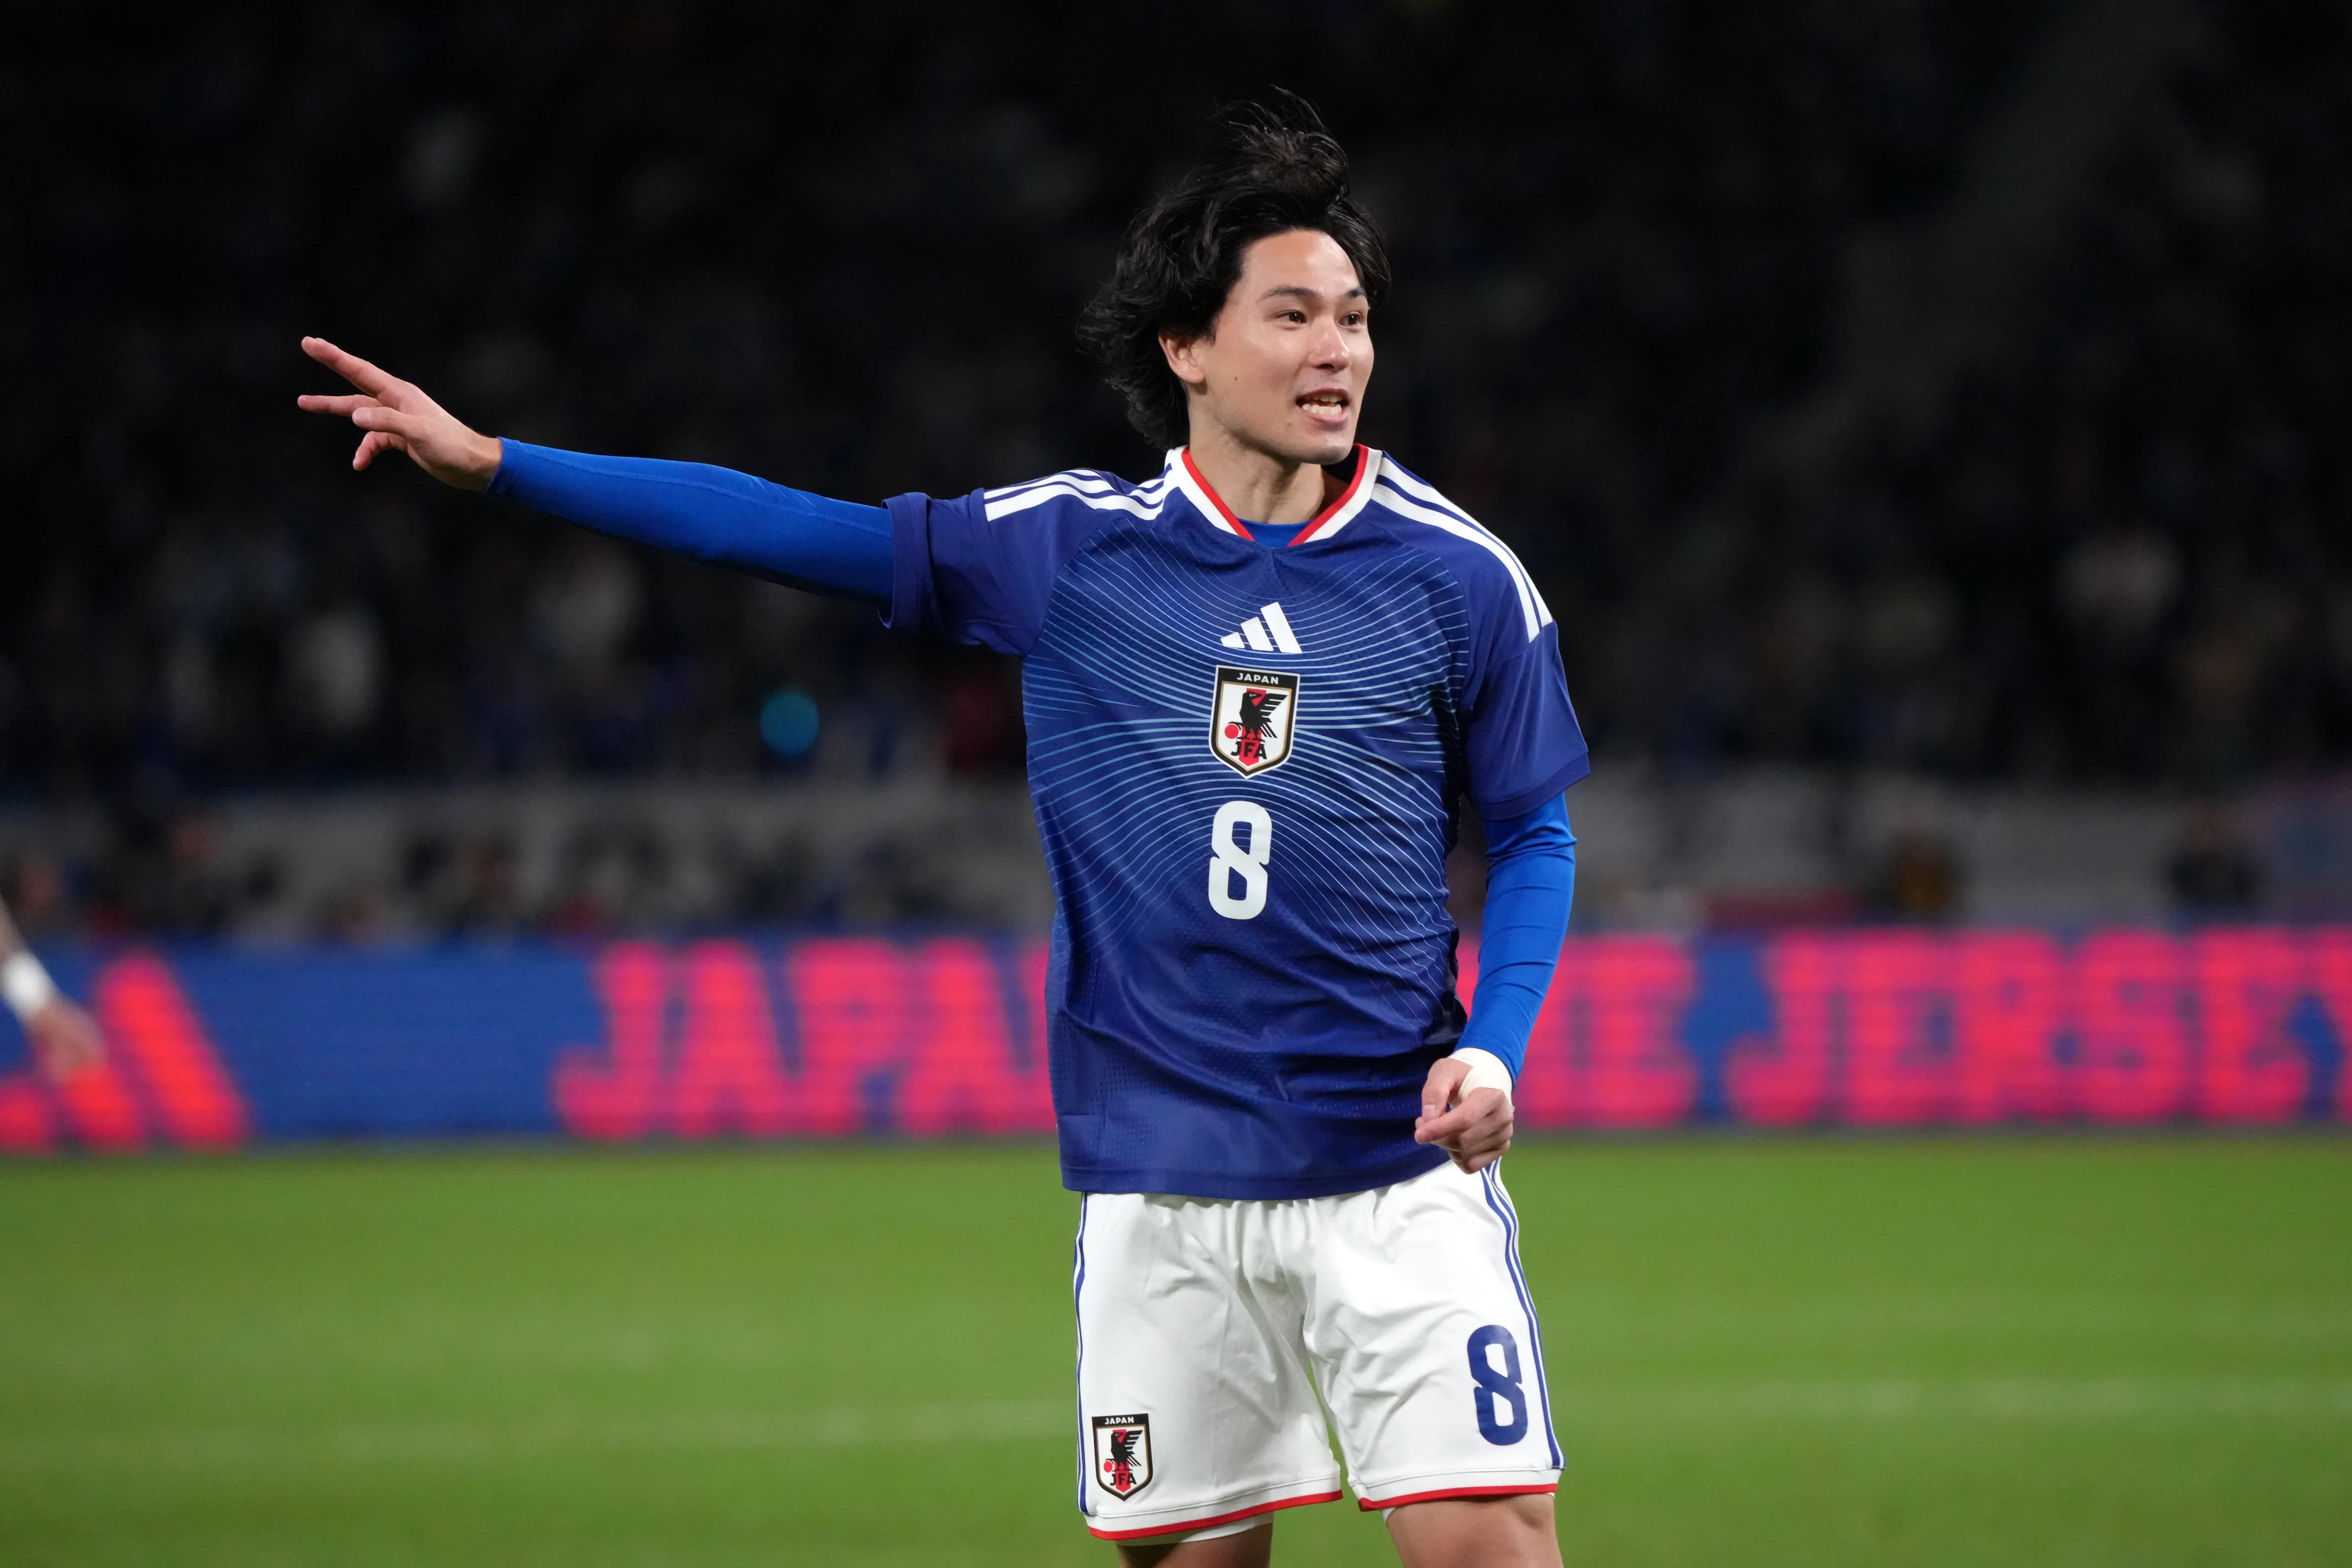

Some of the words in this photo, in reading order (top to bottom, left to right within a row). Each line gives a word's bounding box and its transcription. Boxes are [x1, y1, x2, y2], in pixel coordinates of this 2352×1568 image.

[1236, 672, 1279, 685] JAPAN
[1230, 740, 1267, 760] JFA
[1208, 801, 1273, 920] 8
[553, 933, 1058, 1141] JAPA
[1467, 1324, 1528, 1446] 8
[1105, 1417, 1134, 1425] JAPAN
[1110, 1472, 1137, 1486] JFA
